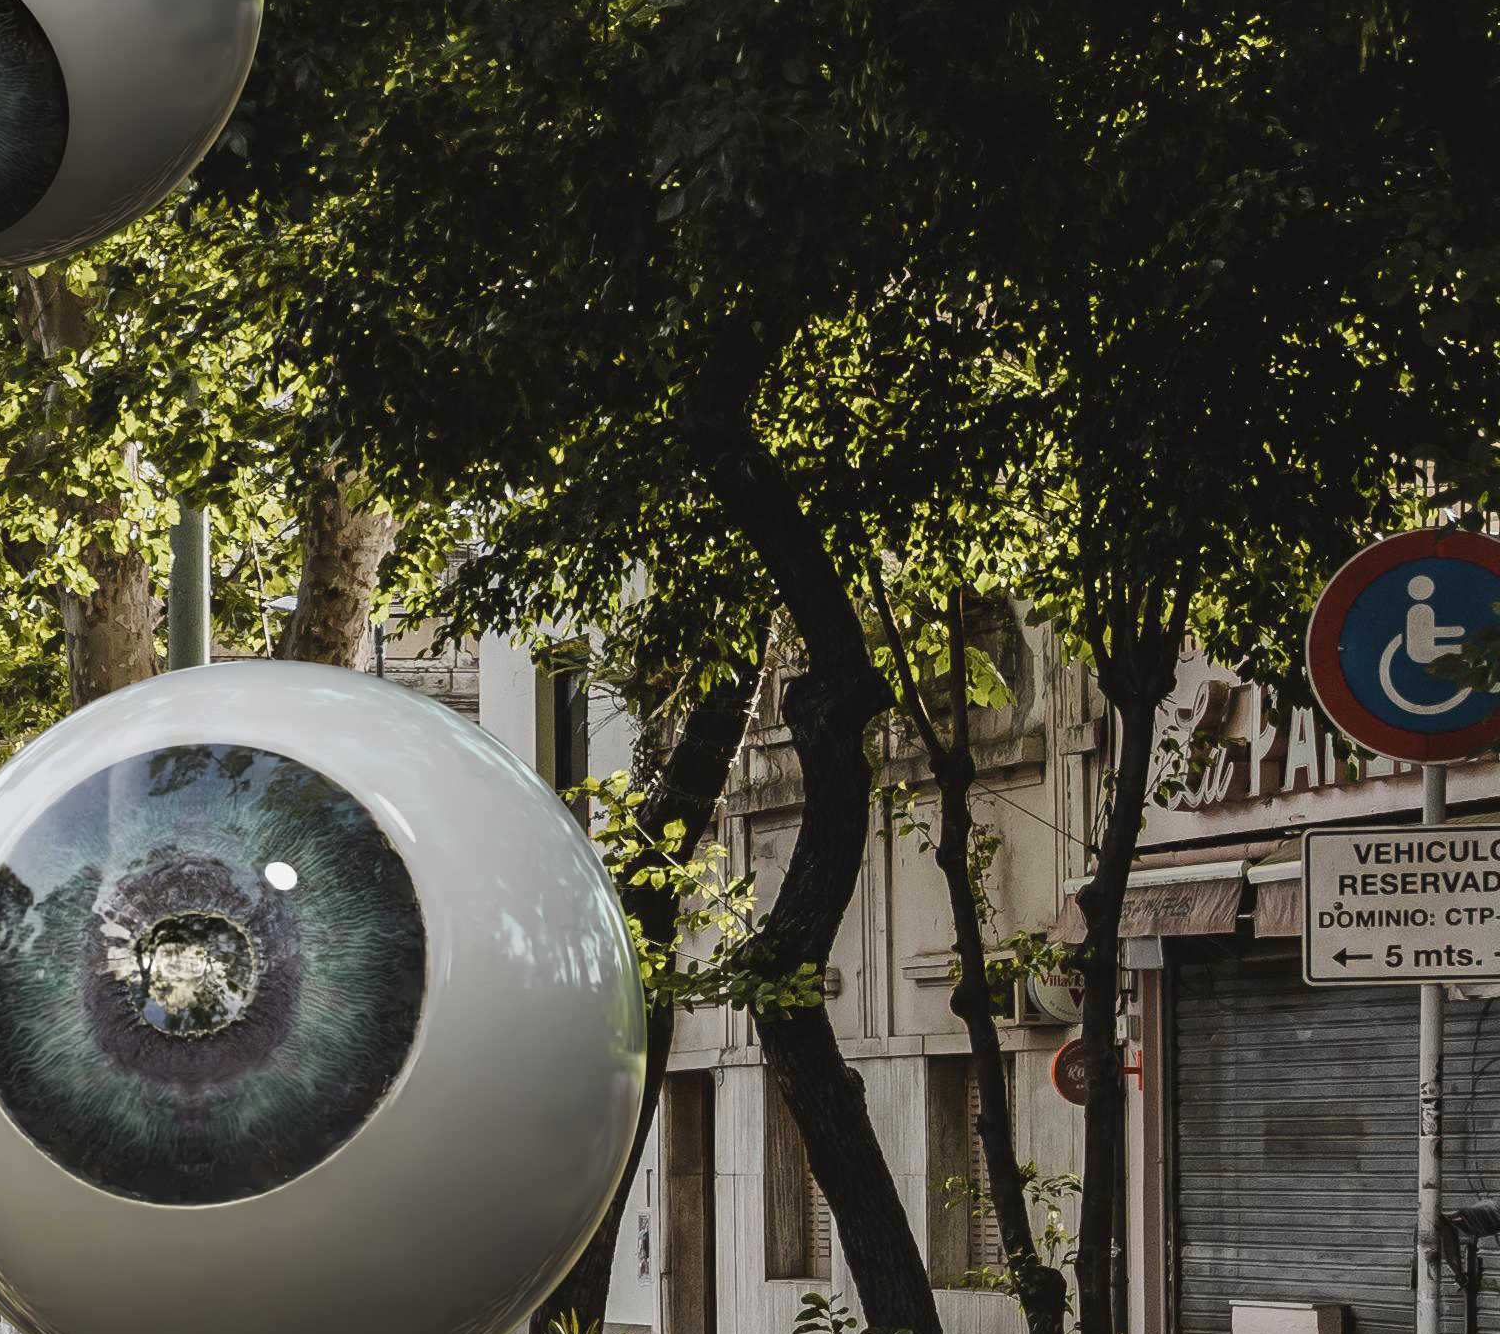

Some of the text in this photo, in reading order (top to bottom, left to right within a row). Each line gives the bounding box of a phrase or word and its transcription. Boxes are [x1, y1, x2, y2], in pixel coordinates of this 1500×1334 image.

[1318, 908, 1436, 929] DOMINIO:
[1384, 944, 1483, 968] 5 mts.
